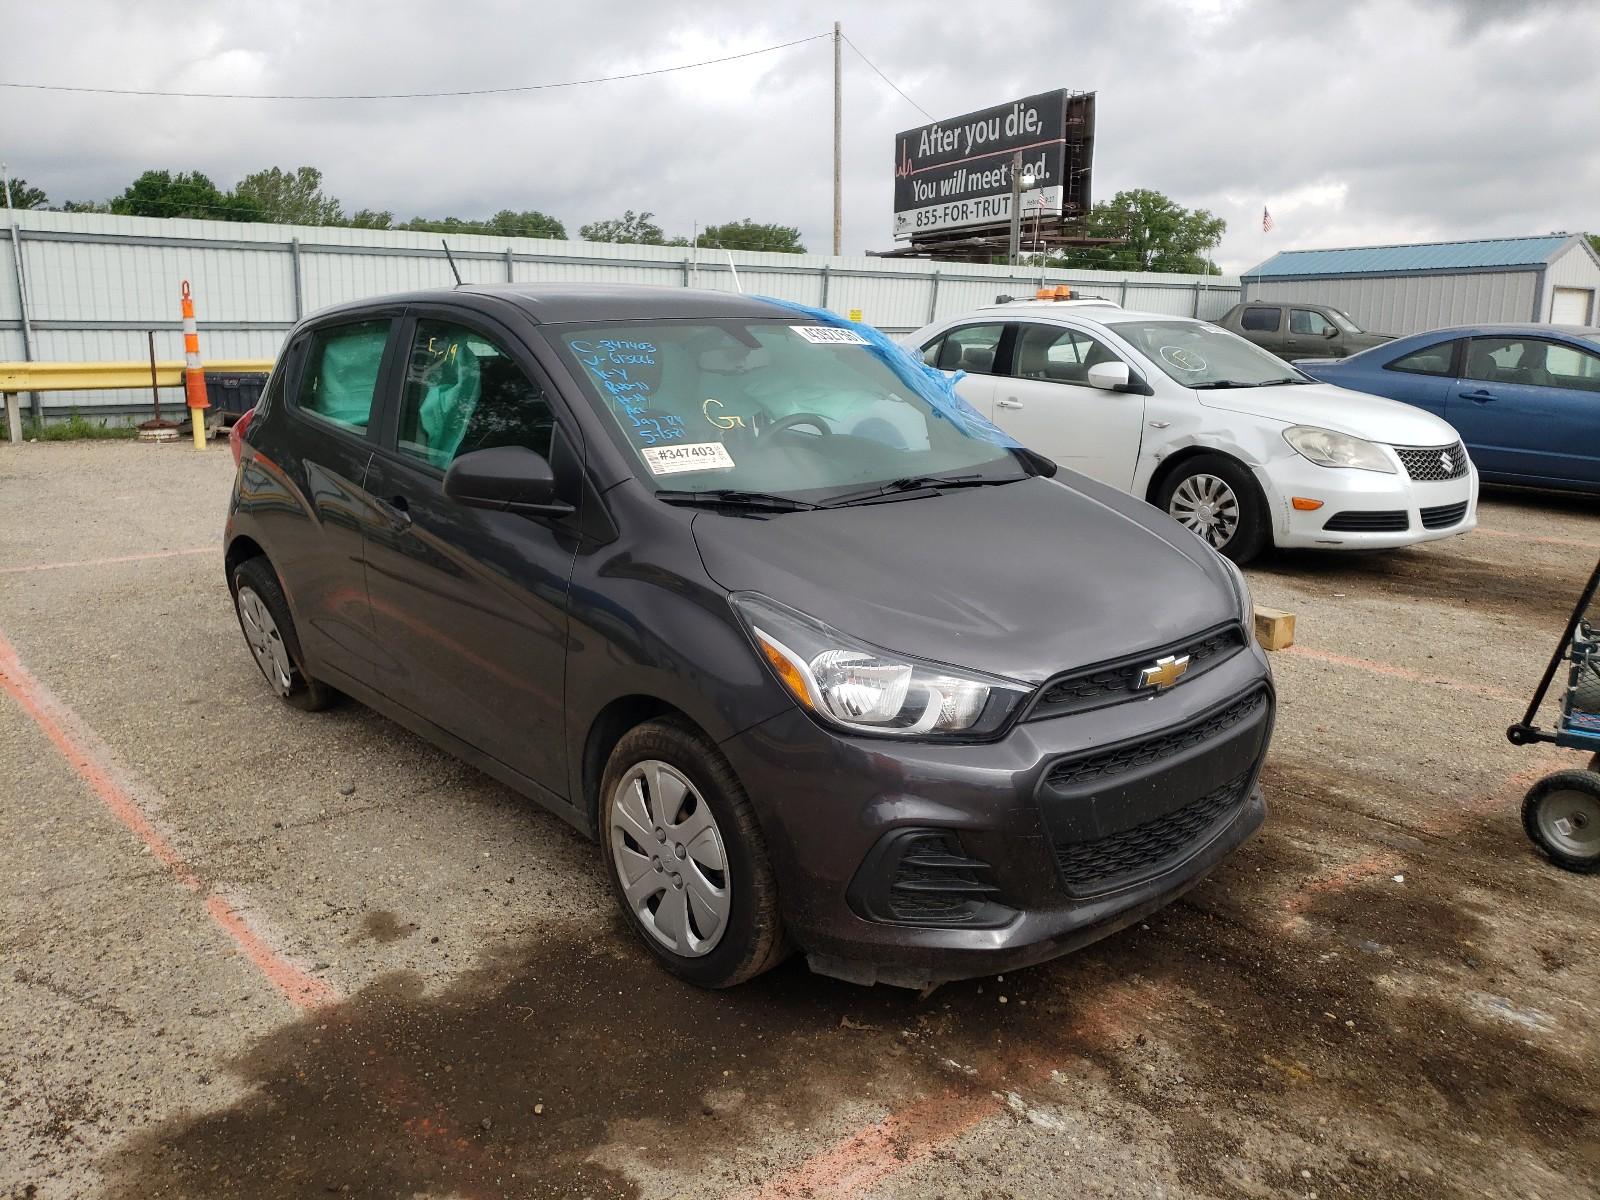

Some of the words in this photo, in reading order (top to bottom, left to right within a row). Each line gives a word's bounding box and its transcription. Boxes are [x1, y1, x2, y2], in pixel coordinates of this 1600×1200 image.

[918, 124, 961, 158] After
[965, 117, 1000, 155] you
[1005, 102, 1043, 136] die,
[912, 179, 937, 201] You
[940, 168, 967, 197] will
[967, 164, 1009, 192] meet
[1010, 152, 1051, 183] od.
[916, 196, 1011, 227] 855-FOR-TRUT
[658, 446, 716, 461] #347403
